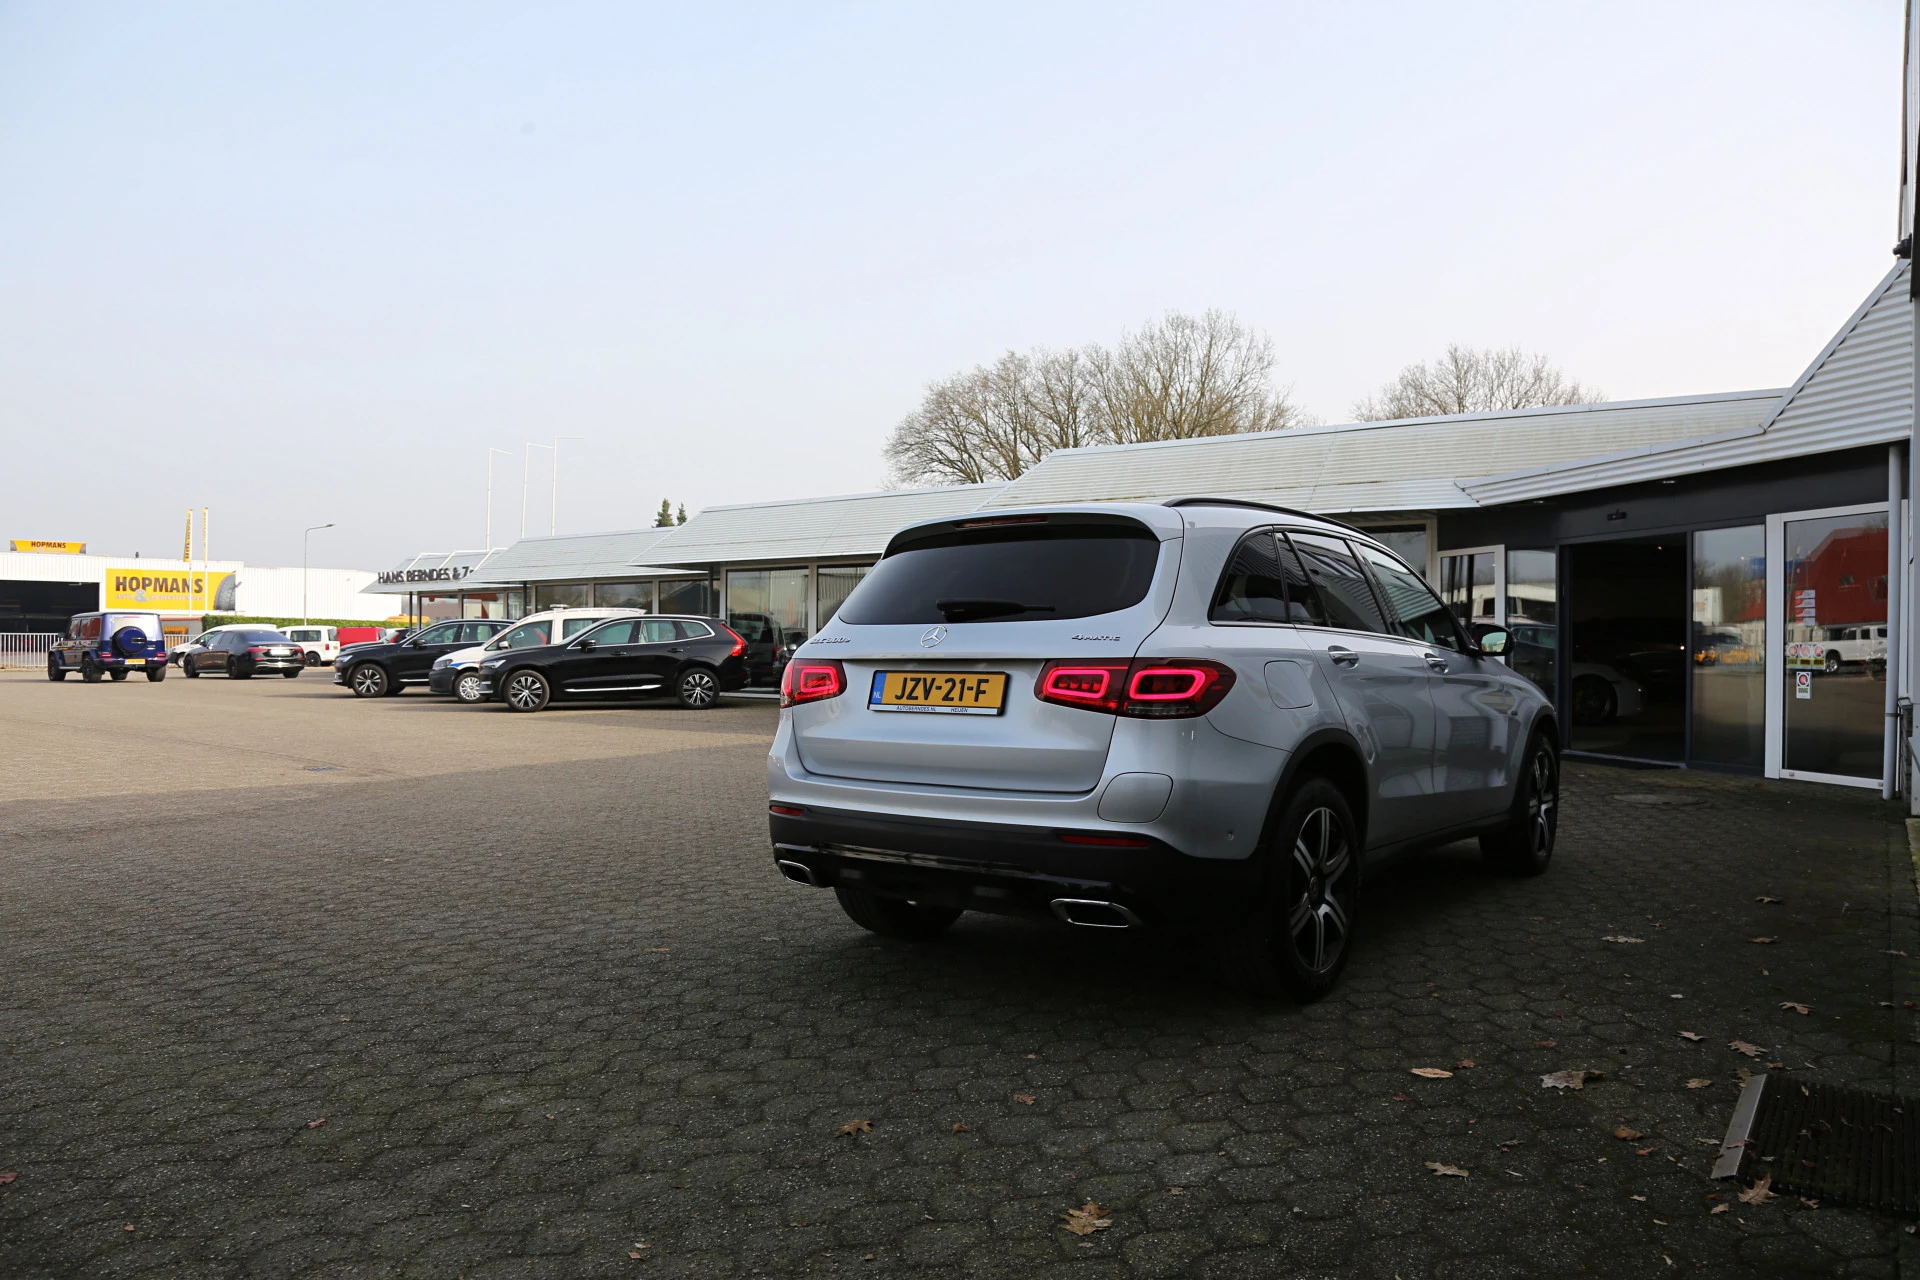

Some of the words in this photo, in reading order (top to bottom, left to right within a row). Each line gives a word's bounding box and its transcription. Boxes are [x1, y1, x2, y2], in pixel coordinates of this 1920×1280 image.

[31, 541, 66, 549] HOPMANS
[377, 571, 404, 583] HANS
[406, 568, 450, 581] BERNDES
[452, 567, 461, 580] &
[115, 576, 203, 594] HOPMANS
[1071, 634, 1121, 642] 4MATIC
[873, 691, 881, 699] NL
[894, 677, 990, 703] JZV-21-F
